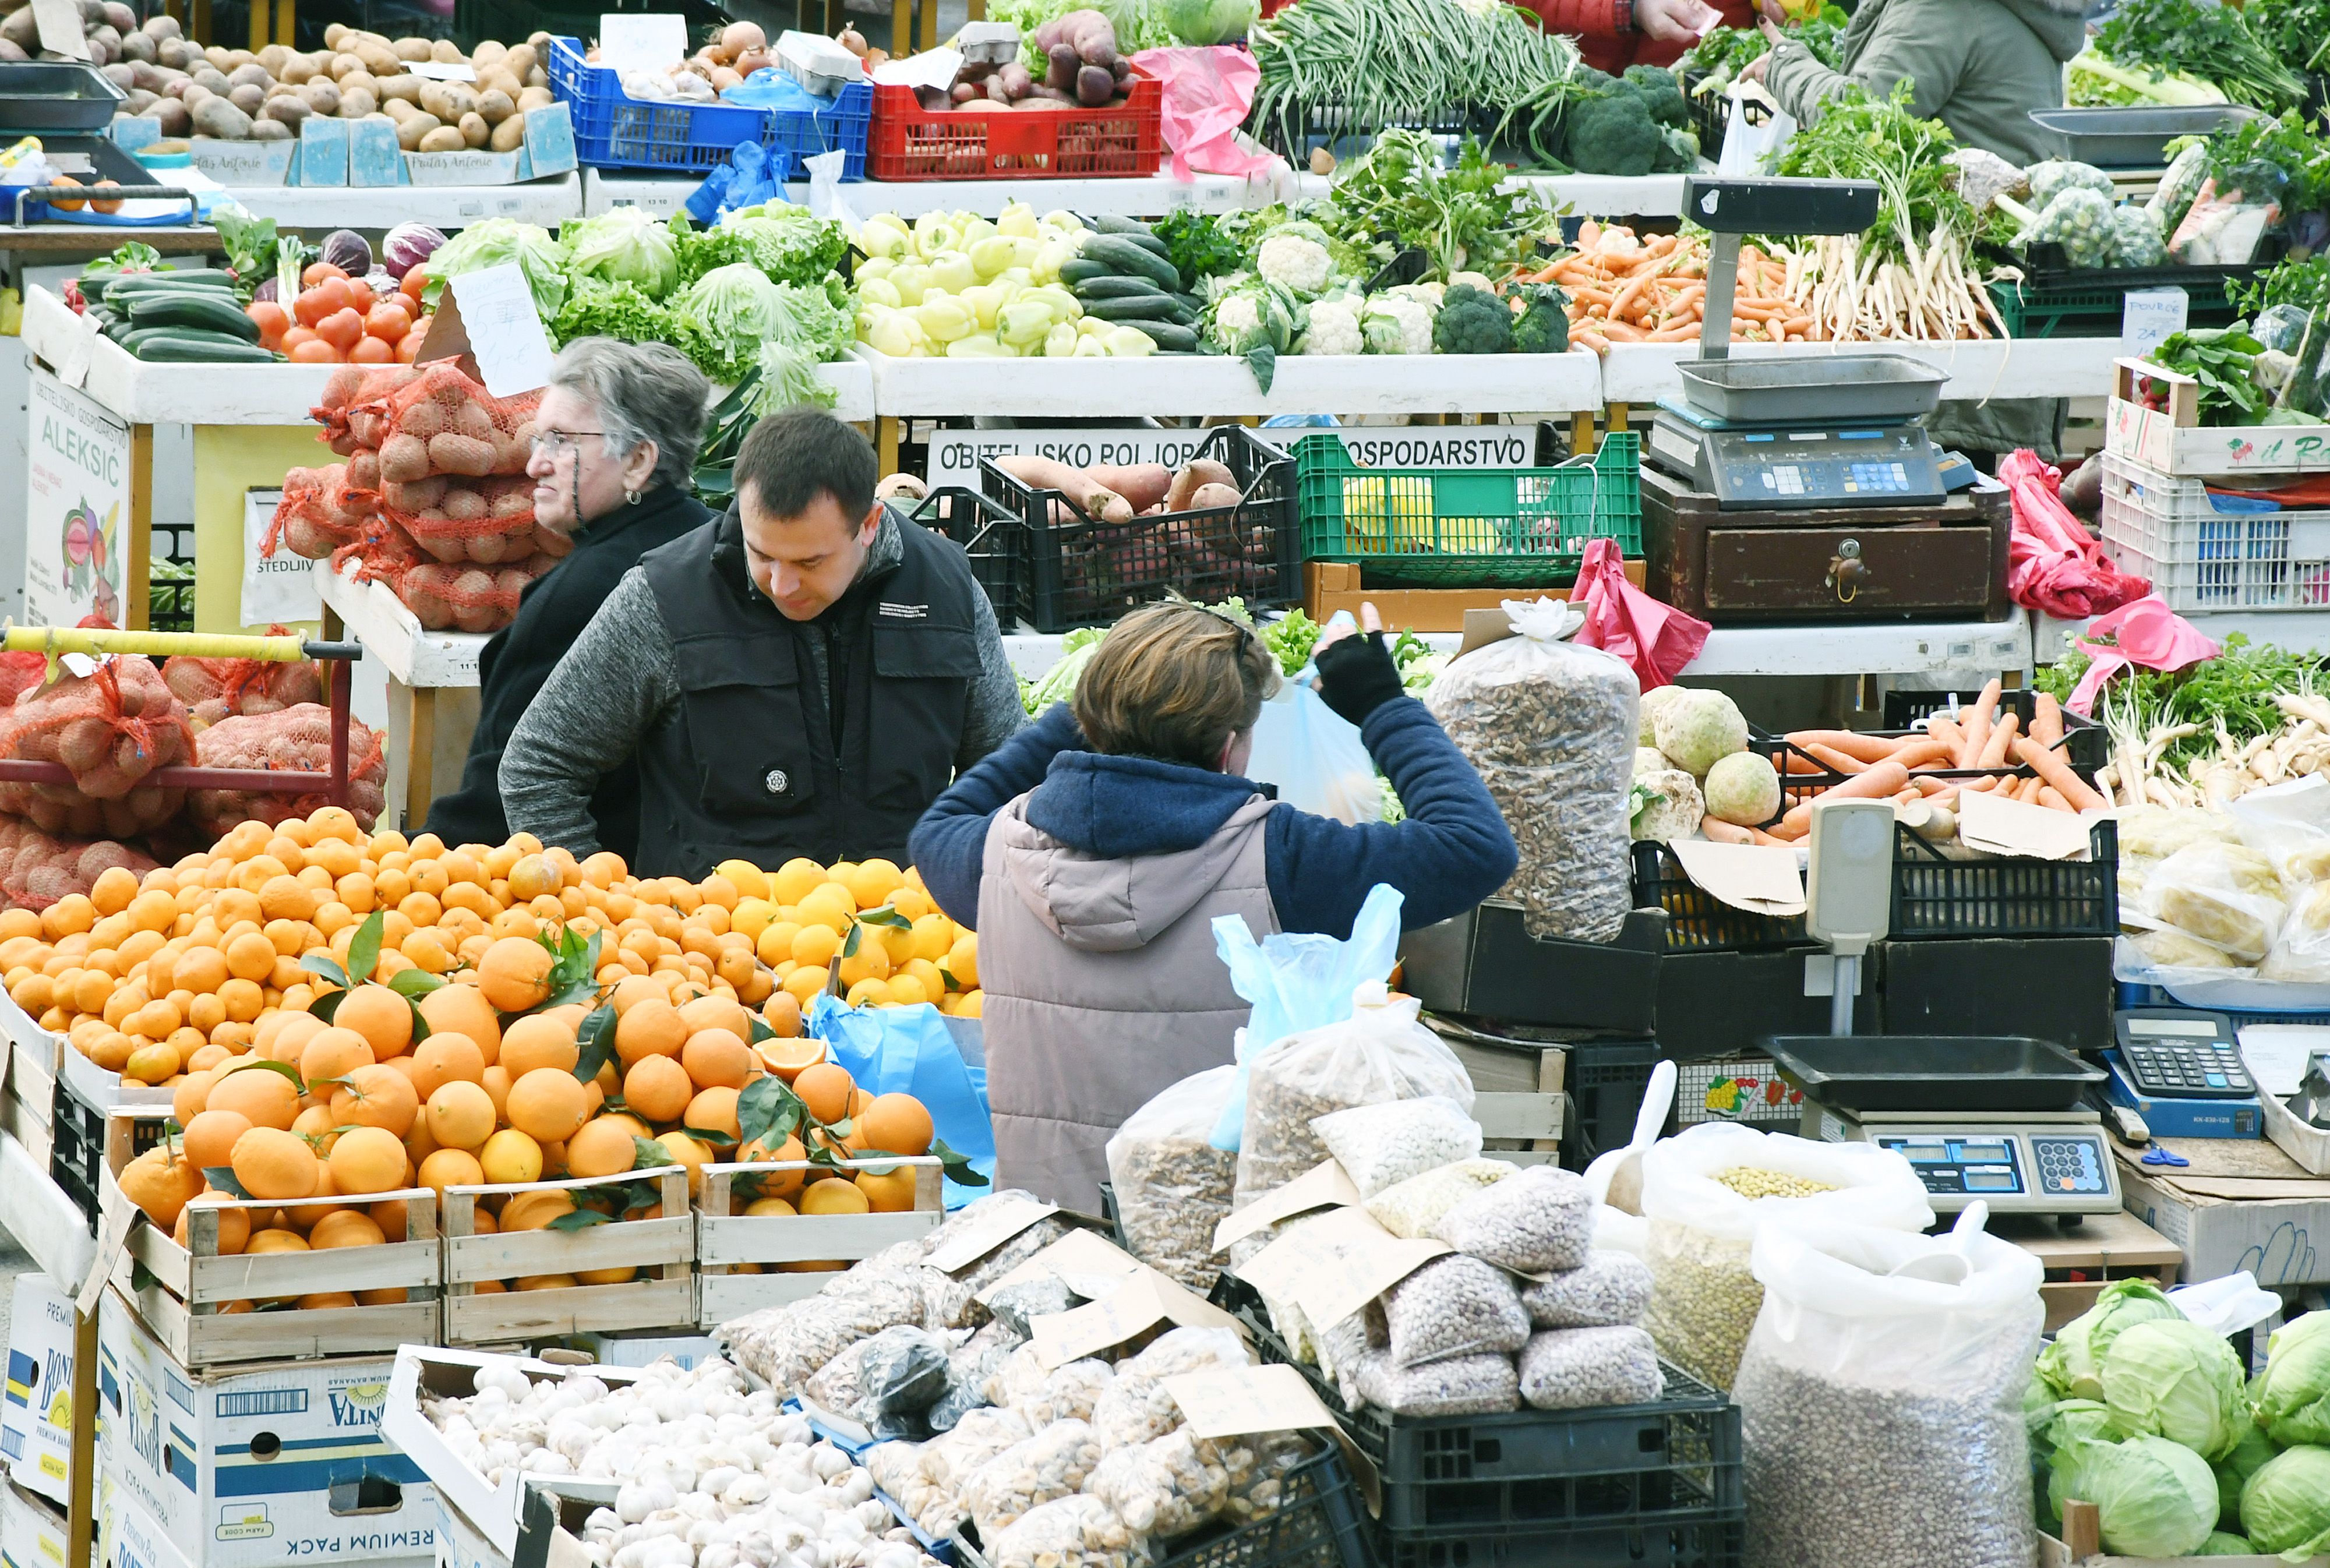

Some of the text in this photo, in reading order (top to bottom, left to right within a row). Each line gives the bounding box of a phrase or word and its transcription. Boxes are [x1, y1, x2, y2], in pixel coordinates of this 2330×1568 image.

[36, 381, 75, 418] OBITELJSKO
[43, 415, 119, 488] ALEKSIĆ
[328, 1378, 367, 1386] BANANAS
[126, 1380, 161, 1478] BONITA
[287, 1537, 341, 1556] PACK
